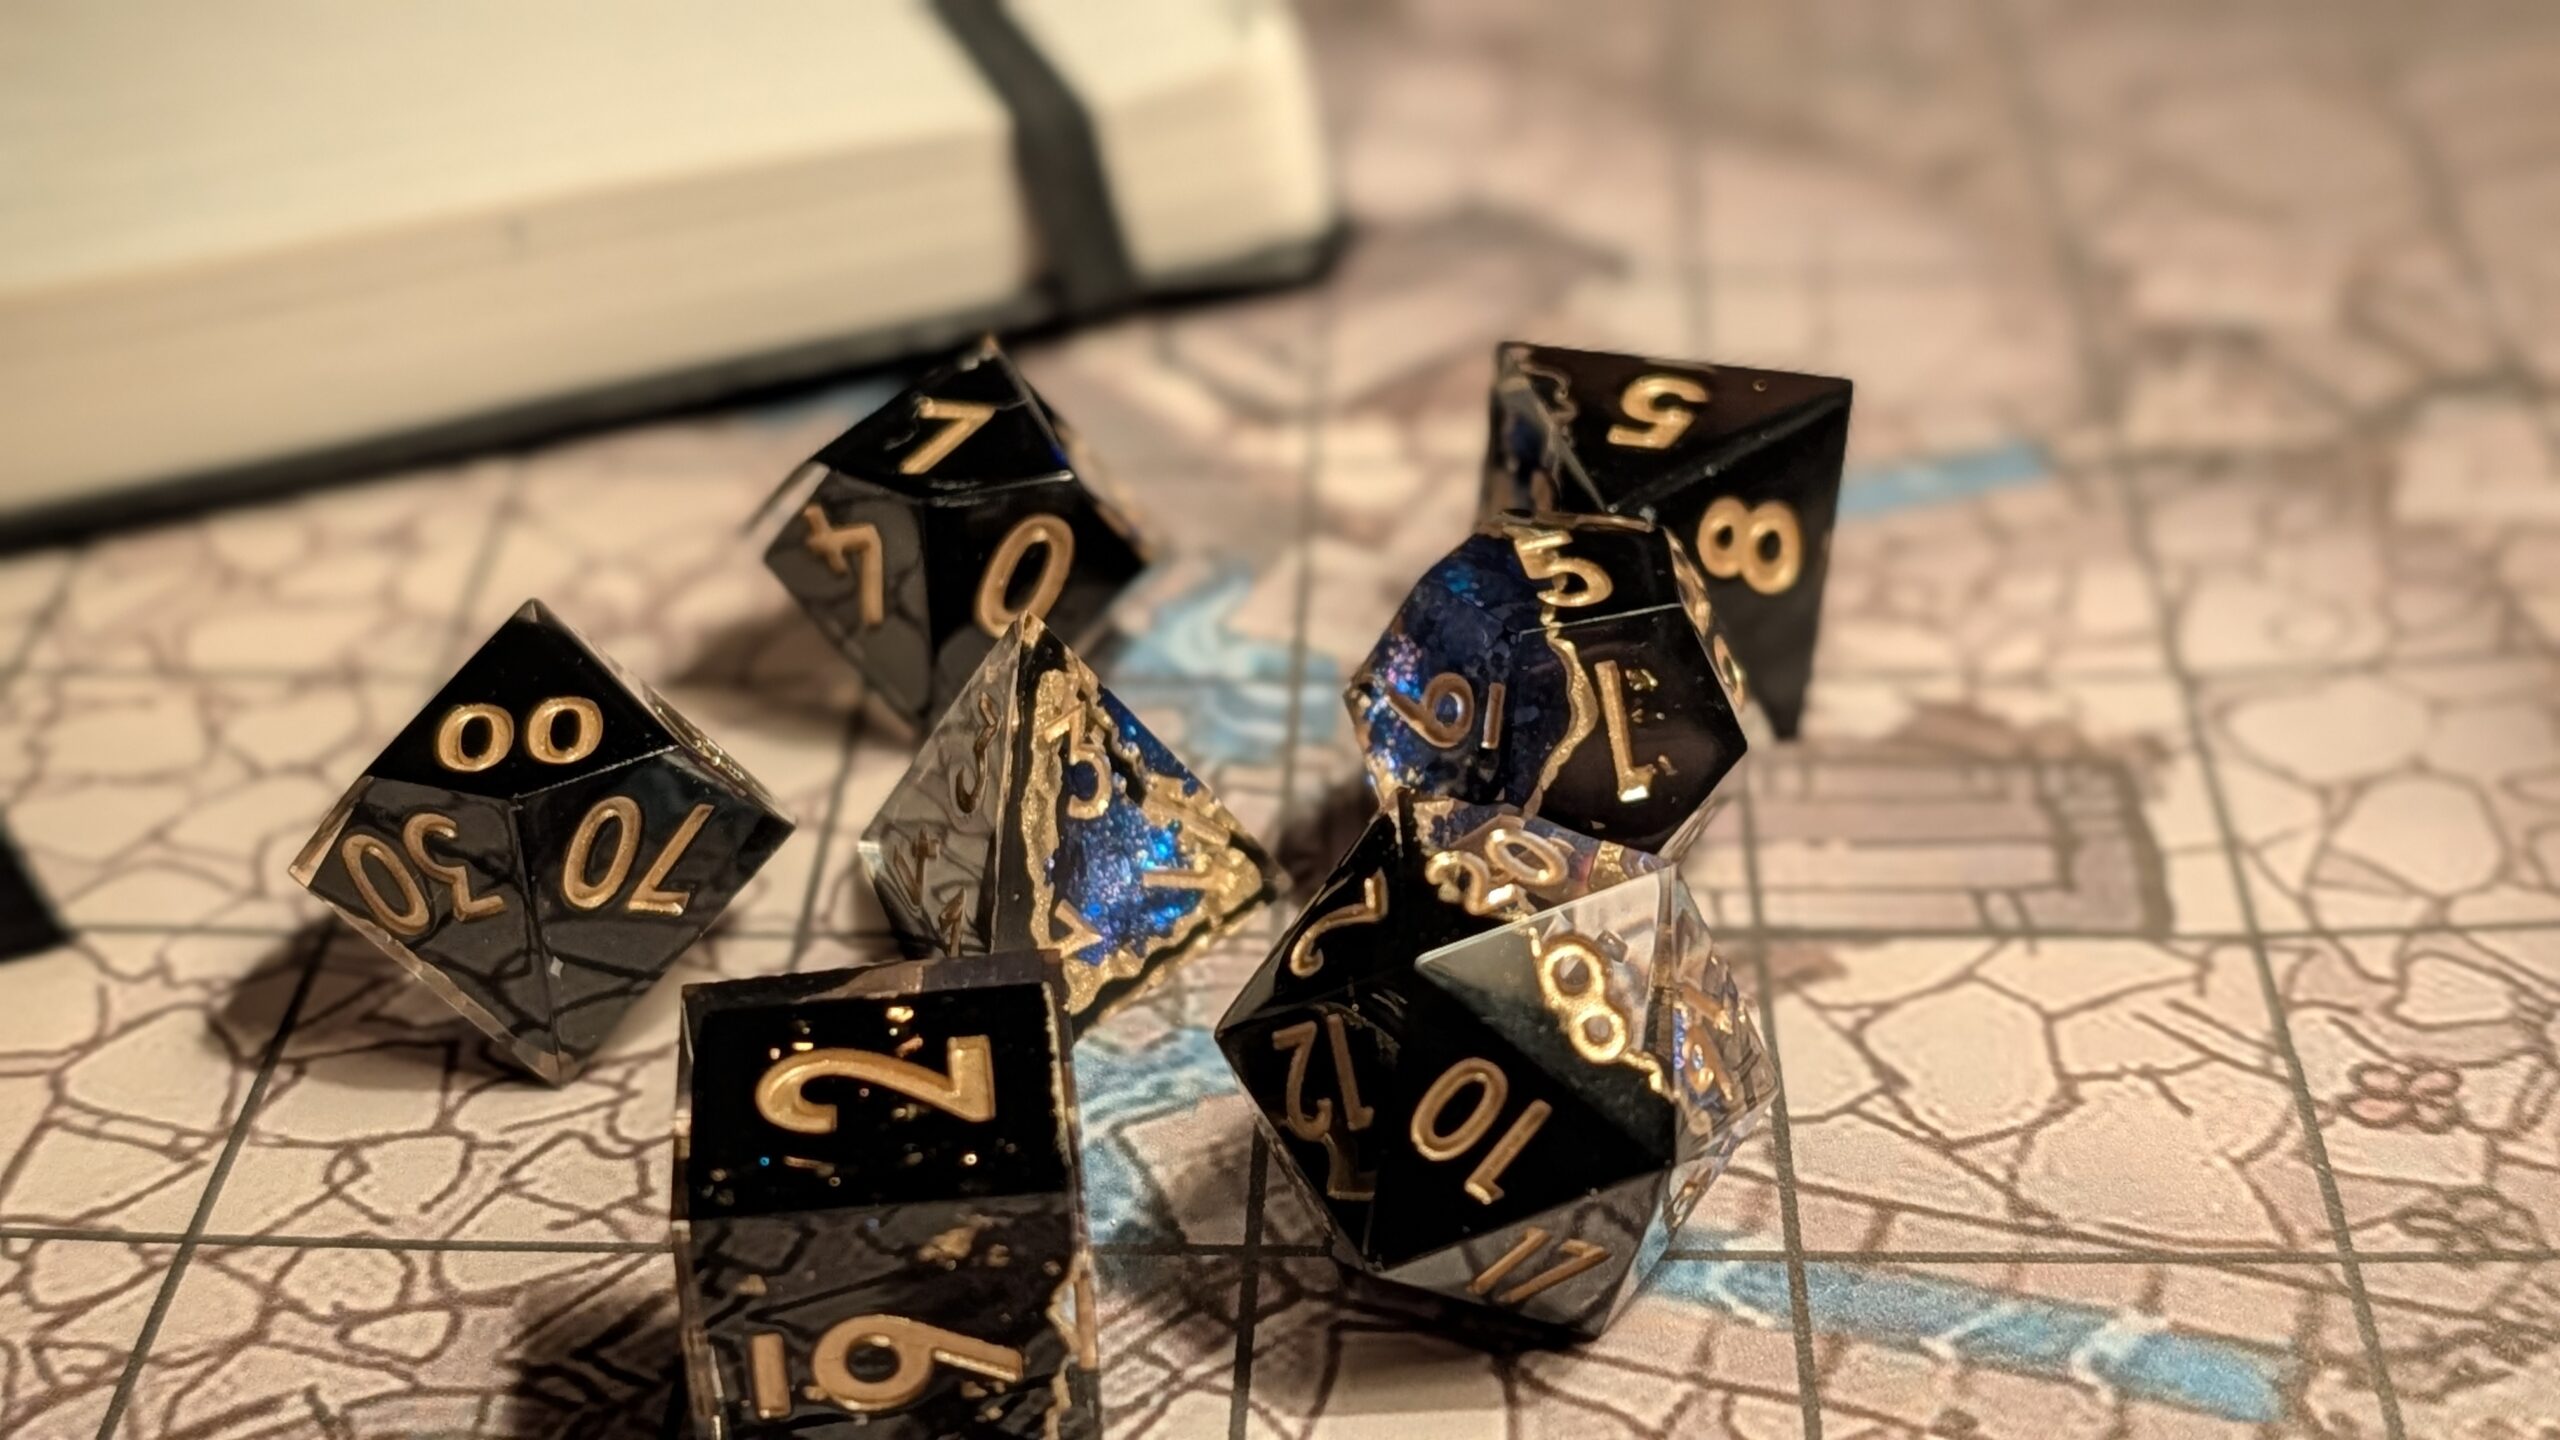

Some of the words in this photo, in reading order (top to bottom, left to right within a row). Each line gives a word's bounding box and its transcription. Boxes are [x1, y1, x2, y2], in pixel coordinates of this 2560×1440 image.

[901, 398, 997, 475] 7
[1605, 373, 1710, 450] 5
[974, 512, 1076, 640] 0
[1513, 528, 1614, 608] 5
[1696, 494, 1803, 596] 8
[434, 695, 604, 773] 00
[341, 811, 507, 938] 30
[563, 795, 715, 918] 70
[1425, 828, 1569, 917] 20
[1541, 943, 1629, 1064] 8
[755, 1034, 997, 1135] 2
[1272, 1013, 1374, 1132] 12
[1410, 1057, 1554, 1205] 10
[1466, 1226, 1613, 1304] 17
